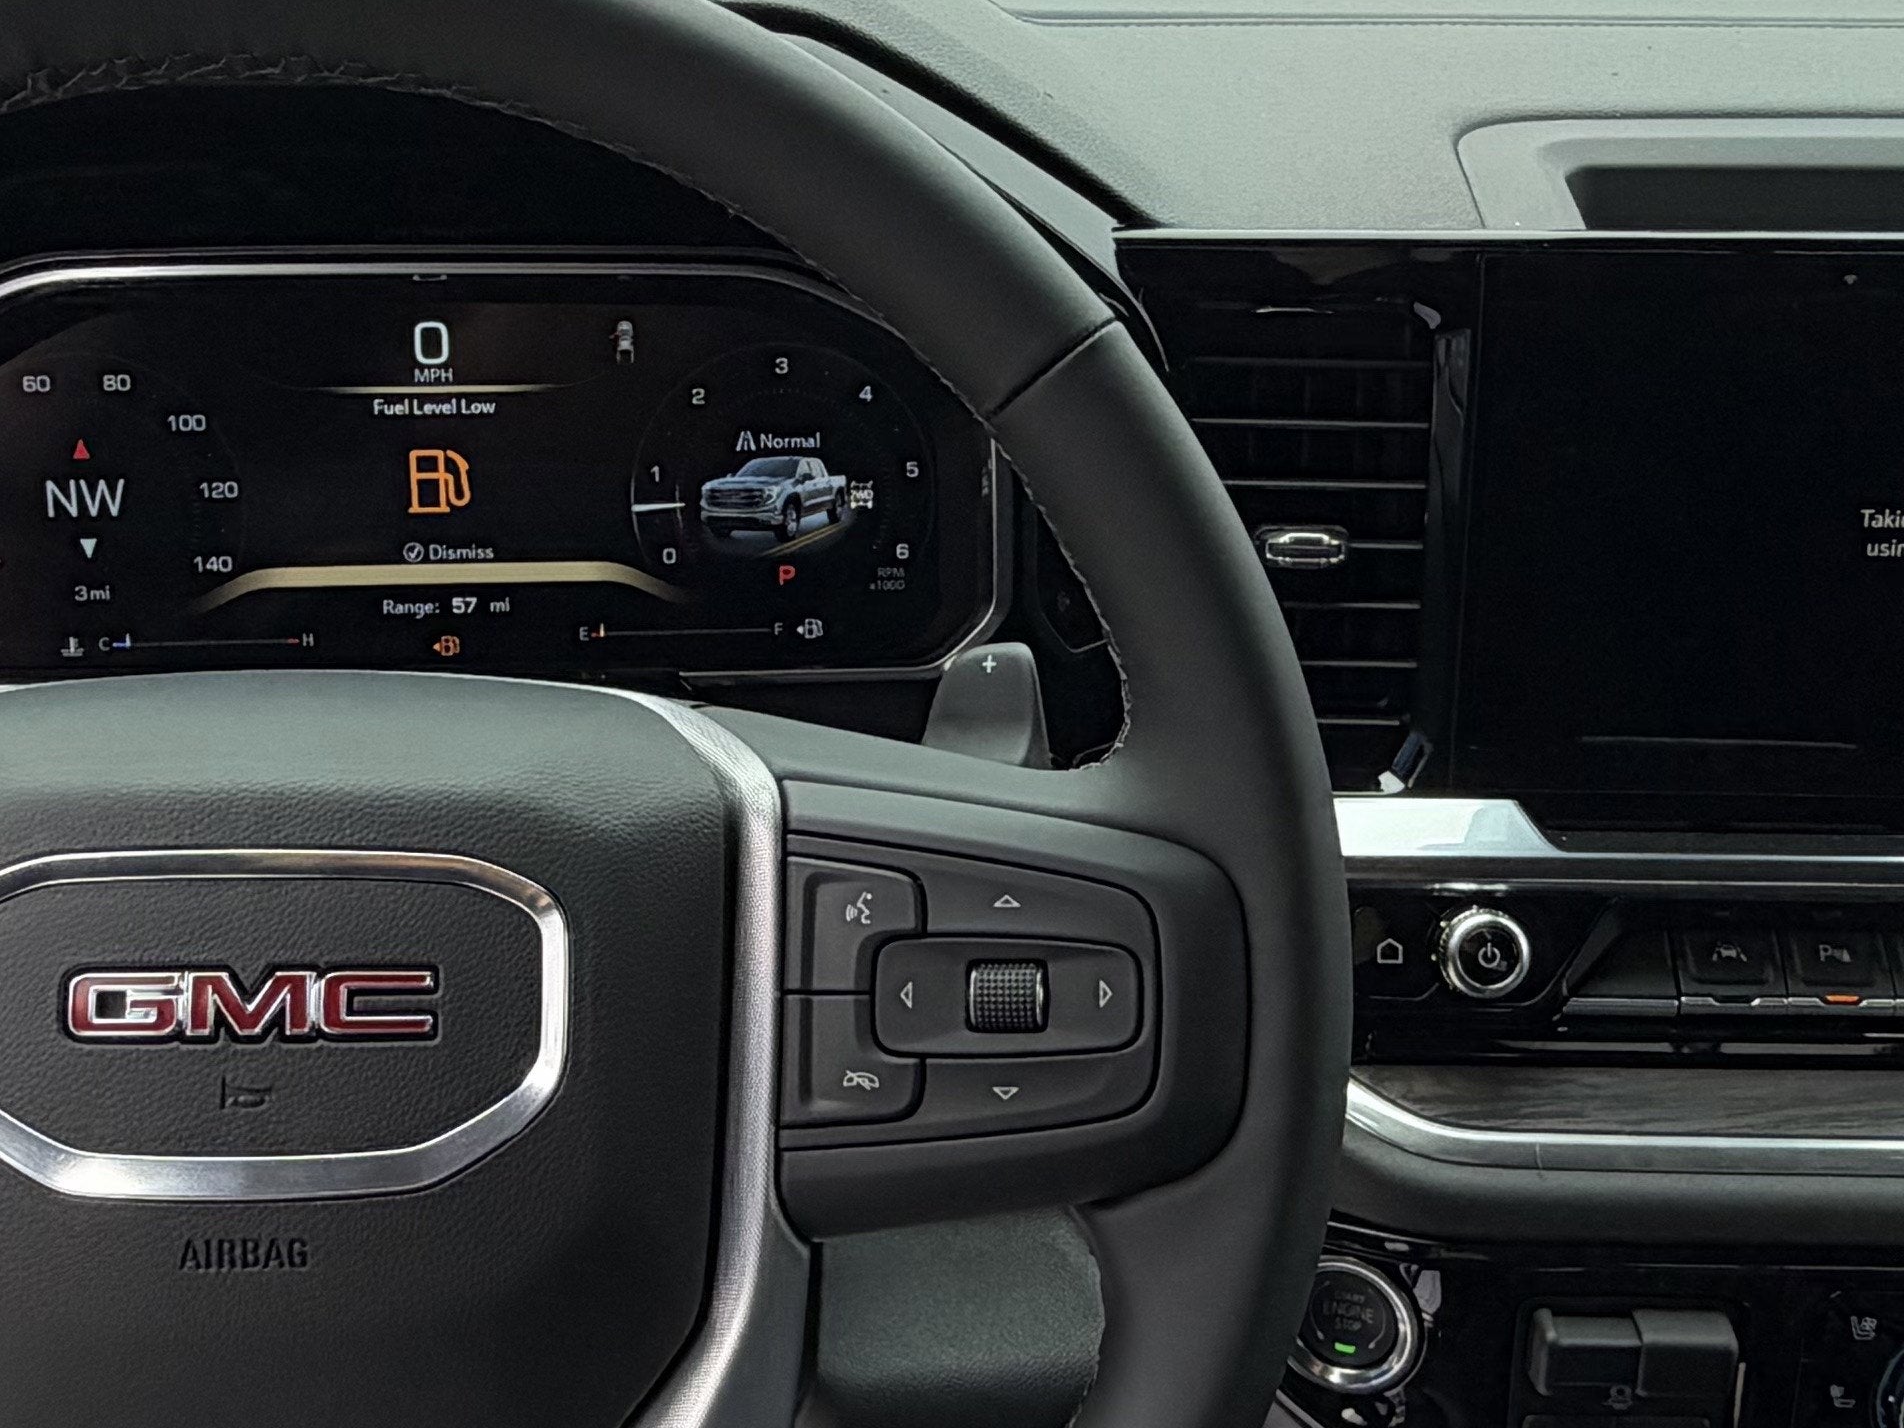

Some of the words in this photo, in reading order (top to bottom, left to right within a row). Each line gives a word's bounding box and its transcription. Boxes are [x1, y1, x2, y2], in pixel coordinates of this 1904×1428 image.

[414, 321, 449, 365] 0
[774, 357, 789, 375] 3
[22, 375, 51, 393] 60
[102, 374, 131, 392] 80
[414, 368, 453, 383] MPH
[691, 388, 705, 406] 2
[859, 385, 873, 402] 4
[373, 398, 410, 415] Fuel
[413, 398, 457, 415] Level
[460, 399, 496, 415] Low
[167, 414, 206, 432] 100
[759, 431, 821, 449] Normal
[650, 465, 661, 483] 1
[906, 461, 919, 478] 5
[45, 478, 125, 518] NW
[199, 481, 239, 499] 120
[428, 543, 494, 560] Dismiss
[662, 548, 676, 565] 0
[896, 543, 910, 560] 6
[193, 556, 233, 573] 140
[779, 565, 796, 586] P
[382, 598, 440, 619] Range:
[451, 596, 477, 614] 57
[490, 596, 510, 612] mi
[579, 627, 590, 642] E
[773, 622, 783, 636] F
[99, 637, 110, 651] C
[302, 633, 314, 647] H
[66, 970, 436, 1037] GMC
[177, 1235, 310, 1273] AIRBAG
